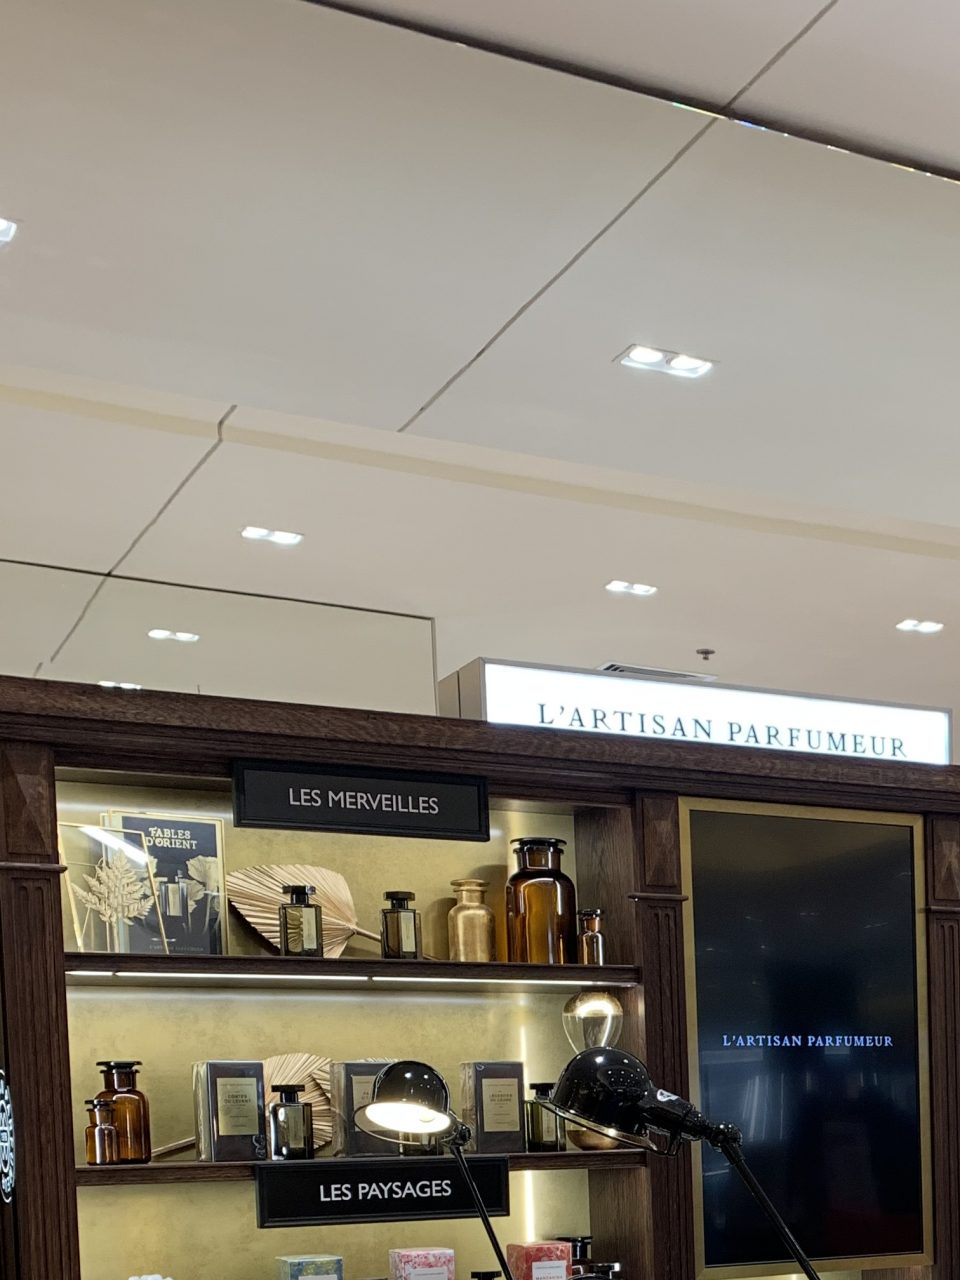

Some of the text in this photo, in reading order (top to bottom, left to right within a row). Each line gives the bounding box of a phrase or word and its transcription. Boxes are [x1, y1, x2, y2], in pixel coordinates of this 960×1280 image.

[537, 703, 908, 758] L'ARTISAN PARFUMEUR
[289, 787, 439, 815] LES MERVEILLES
[148, 826, 192, 840] FABLES
[145, 836, 198, 850] D'ORIENT
[722, 1034, 894, 1047] L'ARTISAN PARFUMEUR
[319, 1180, 452, 1202] LES PAYSAGES
